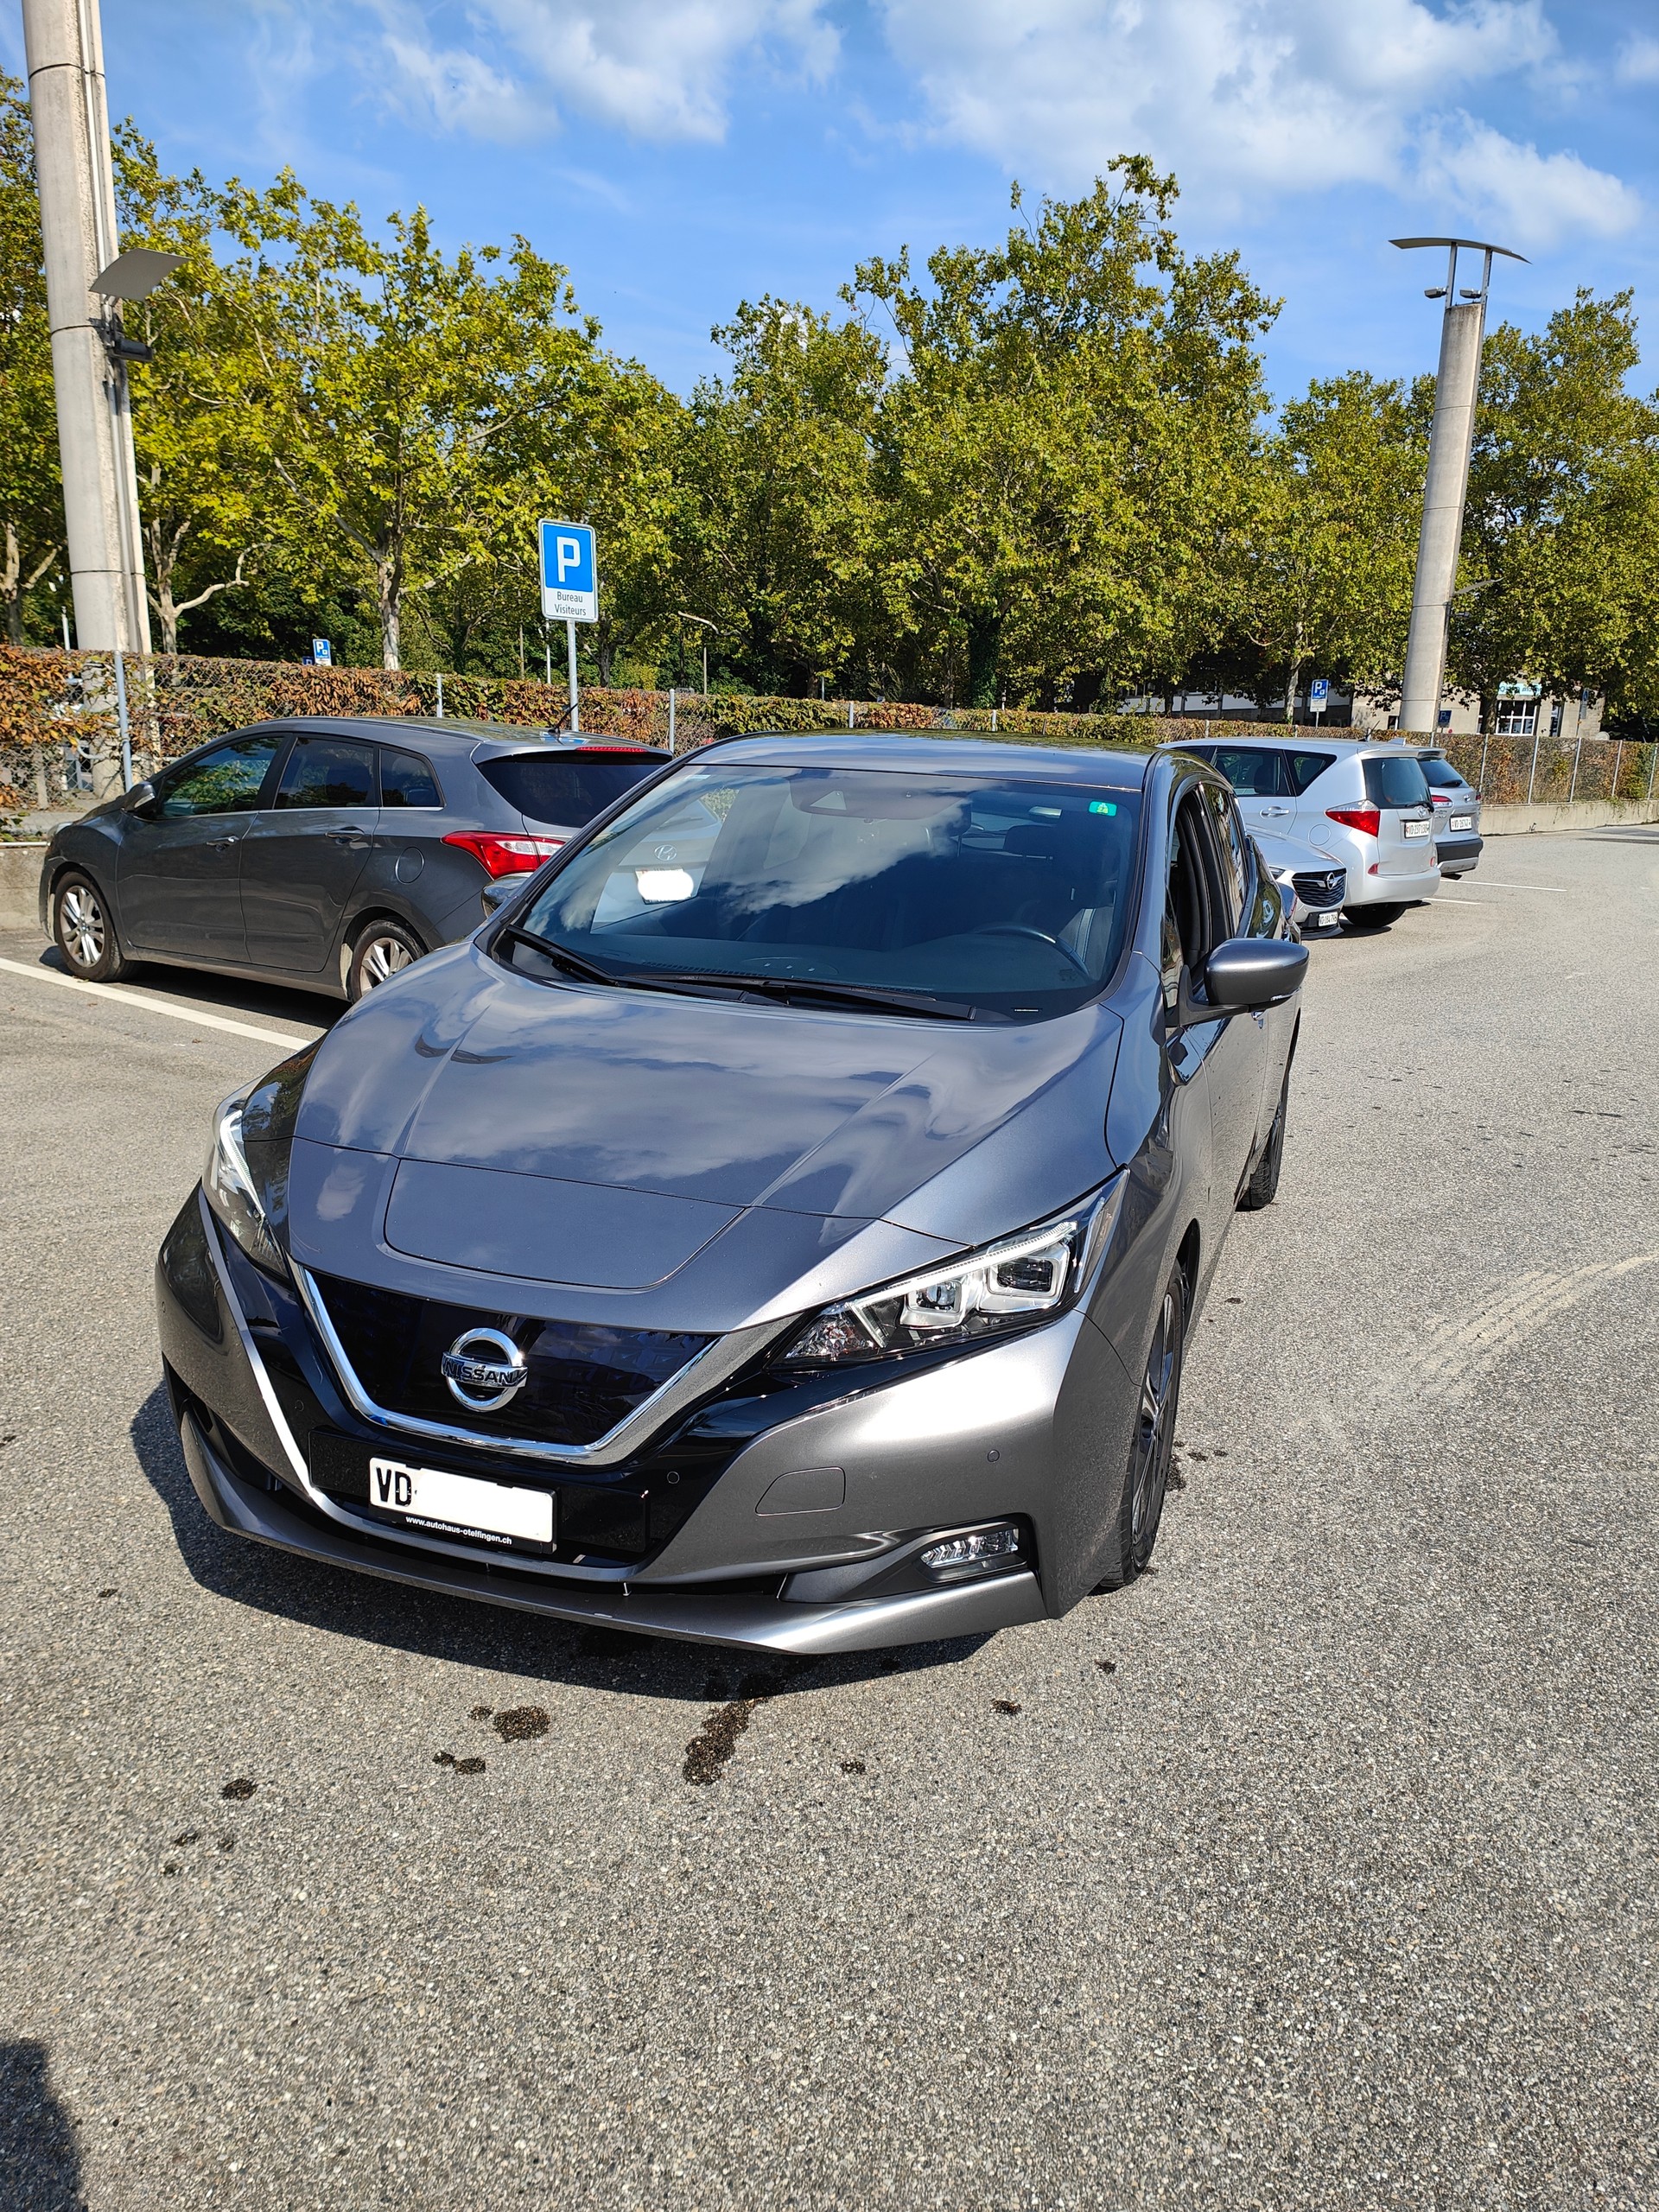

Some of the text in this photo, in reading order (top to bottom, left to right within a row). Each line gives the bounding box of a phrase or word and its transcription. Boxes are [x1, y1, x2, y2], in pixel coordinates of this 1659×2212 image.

[556, 536, 581, 583] P
[554, 604, 587, 616] Visiteurs
[556, 591, 583, 603] Bureau
[443, 1357, 516, 1386] NISSAN
[376, 1467, 412, 1507] VD
[405, 1516, 512, 1545] www.autohaus-otelfingen.ch
